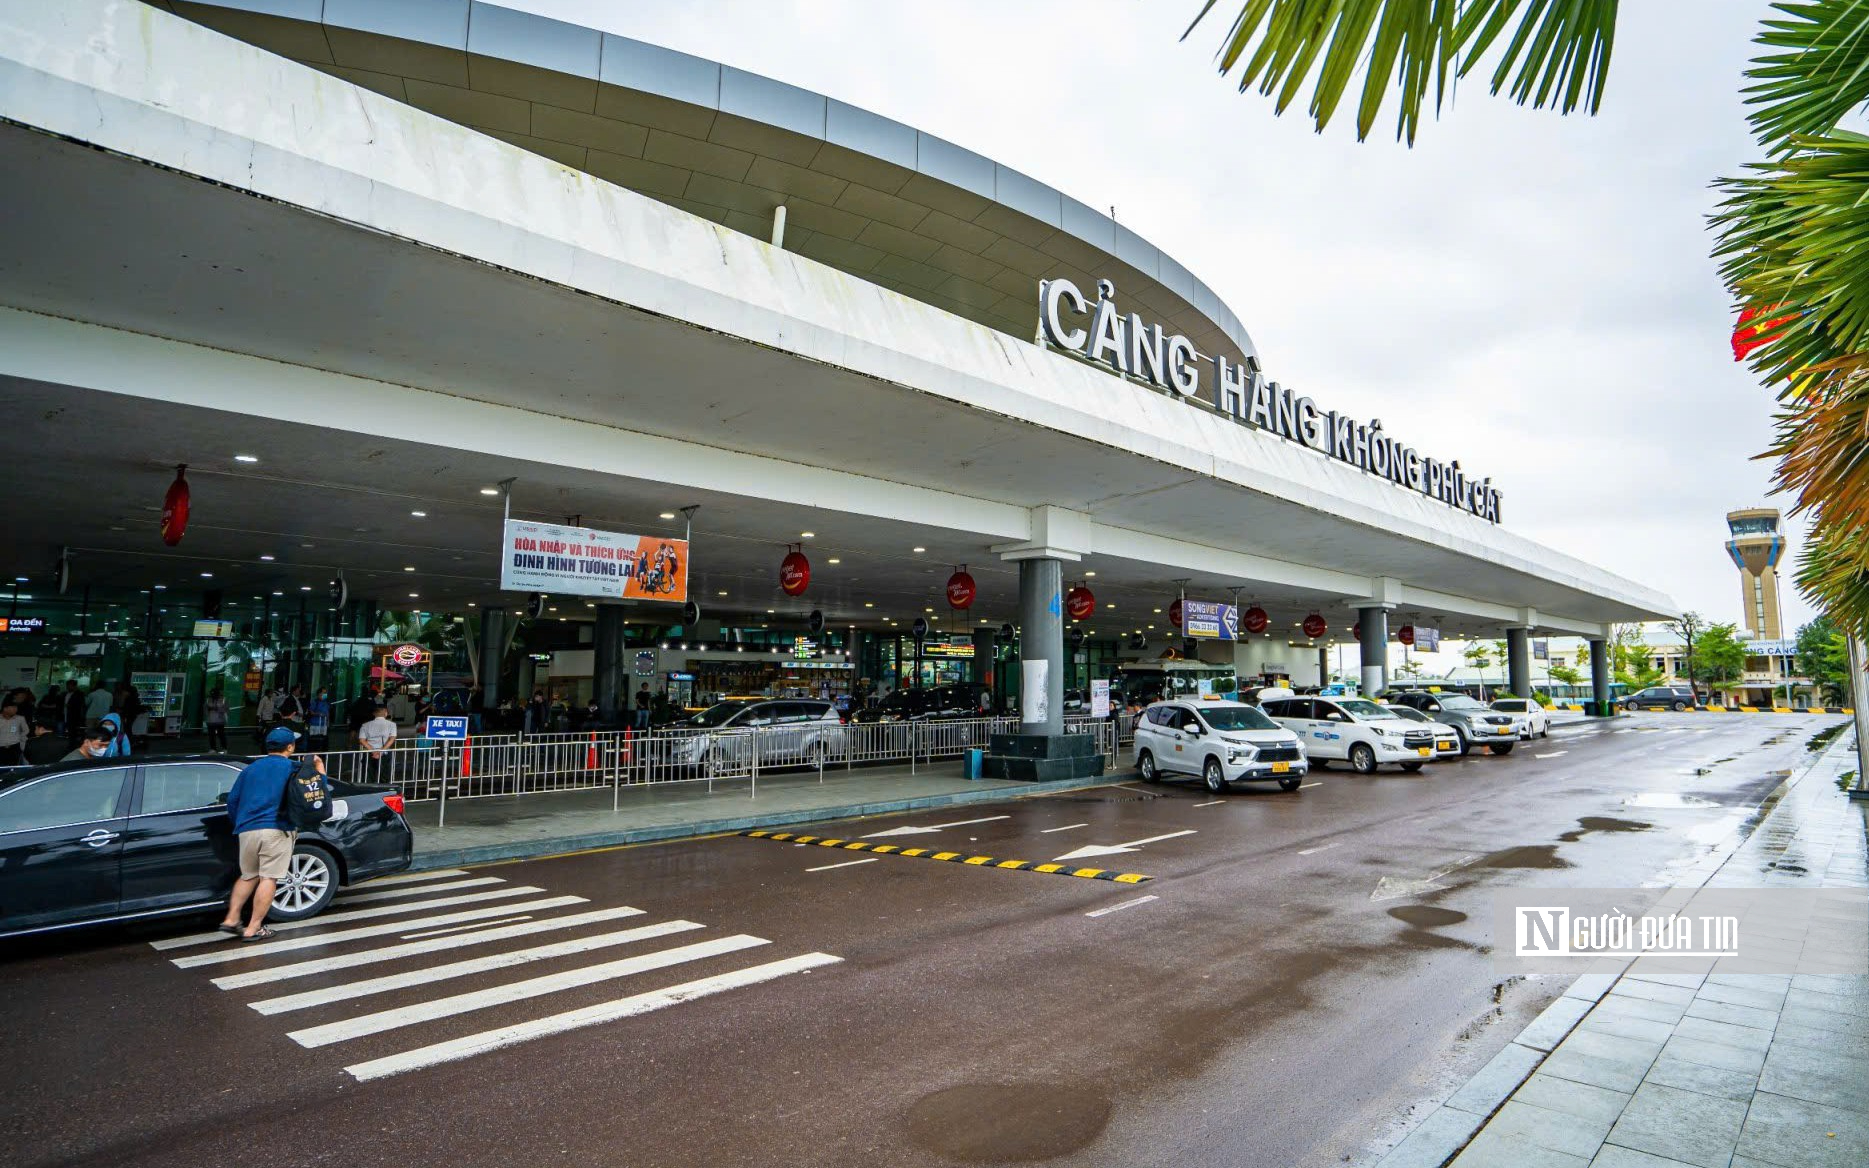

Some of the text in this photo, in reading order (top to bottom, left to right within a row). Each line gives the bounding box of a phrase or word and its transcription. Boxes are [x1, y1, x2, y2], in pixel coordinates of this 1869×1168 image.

[1040, 278, 1504, 523] CẢNG HÀNG KHÔNG PHÙ CÁT
[514, 537, 537, 552] HÒA
[539, 540, 567, 557] NHẬP
[568, 543, 583, 556] VÀ
[584, 545, 614, 560] THÍCH
[513, 554, 635, 578] ĐỊNH HÌNH TƯƠNG LAI
[432, 719, 463, 728] XE TAXI
[306, 781, 320, 792] 12
